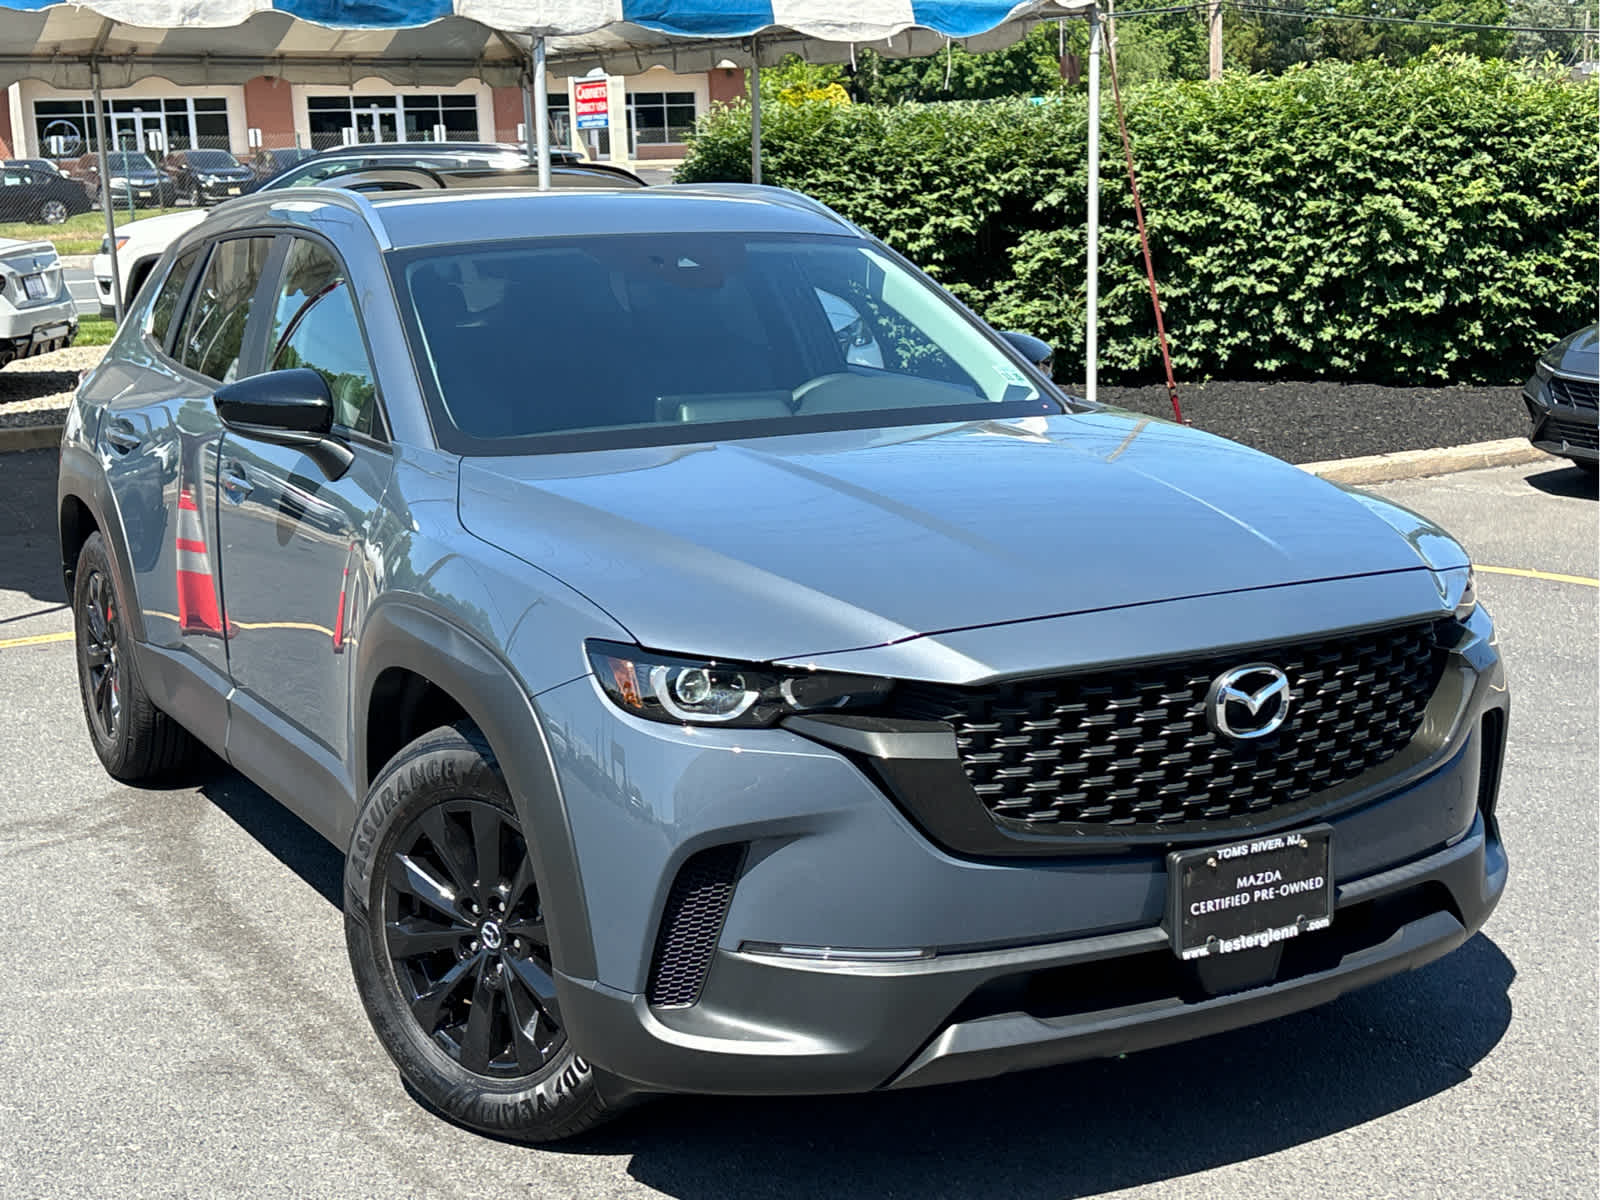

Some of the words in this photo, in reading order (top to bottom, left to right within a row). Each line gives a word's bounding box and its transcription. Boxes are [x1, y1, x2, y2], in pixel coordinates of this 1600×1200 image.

[351, 759, 458, 879] ASSURANCE
[1217, 845, 1248, 860] TOMS
[1287, 834, 1301, 846] NJ
[1236, 870, 1282, 889] MAZDA
[1190, 893, 1250, 915] CERTIFIED
[1254, 876, 1324, 902] PRE-OWNED
[1219, 926, 1298, 953] lesterglenn
